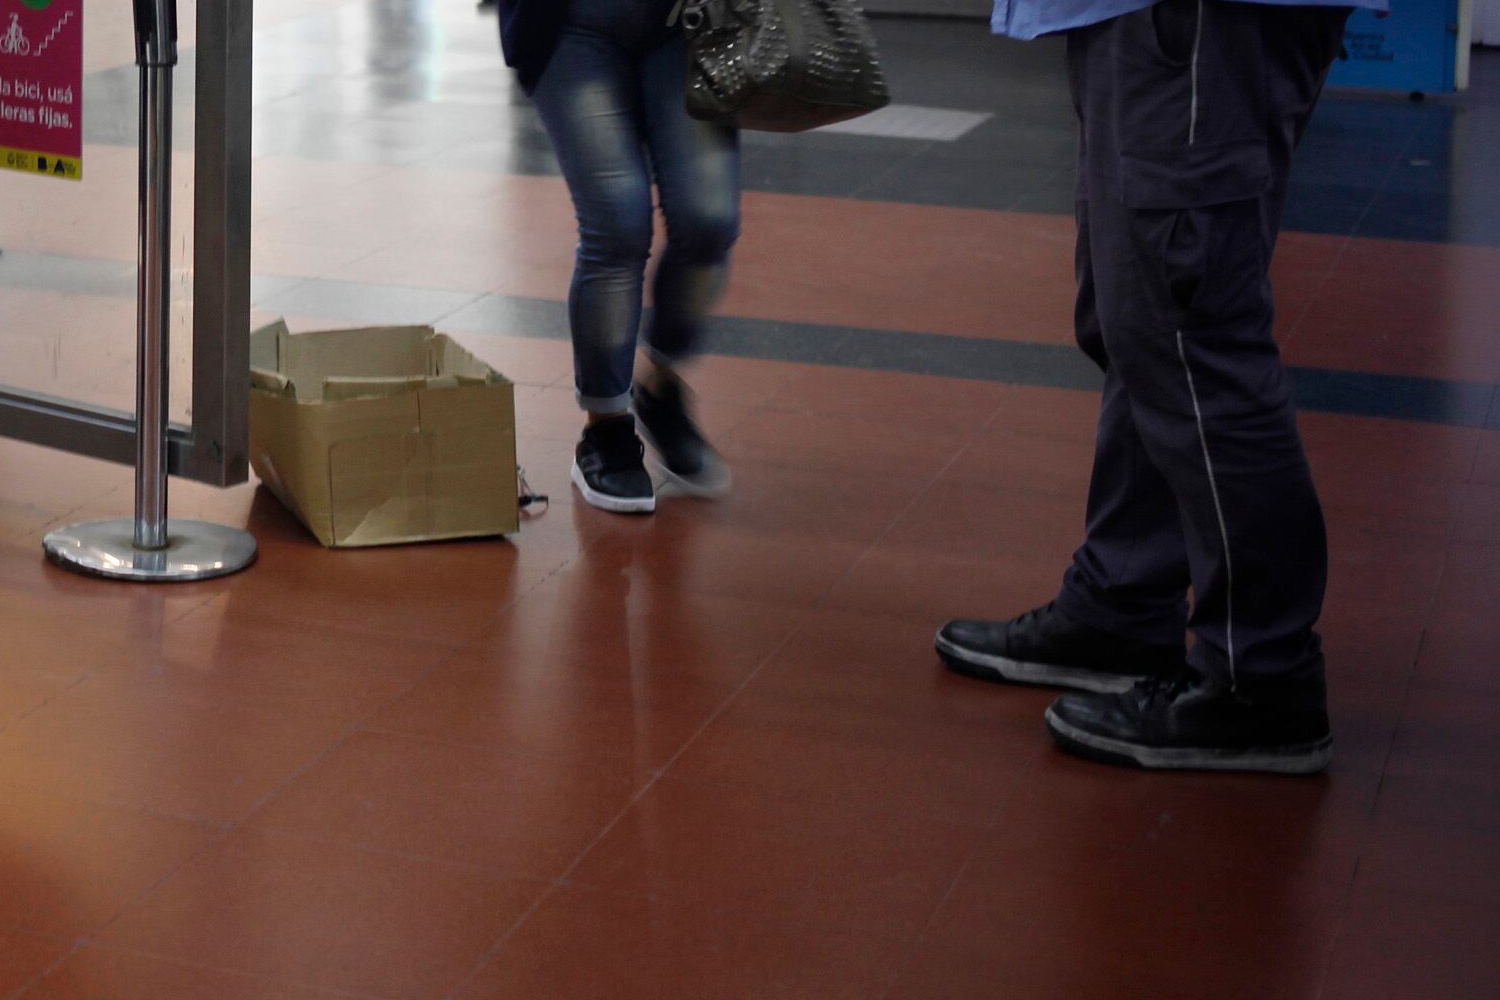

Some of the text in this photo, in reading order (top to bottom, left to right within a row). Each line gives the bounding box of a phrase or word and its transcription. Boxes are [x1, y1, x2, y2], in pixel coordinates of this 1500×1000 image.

[0, 76, 11, 96] la
[15, 78, 44, 103] bici,
[48, 85, 73, 104] usá
[39, 105, 73, 130] fijas.
